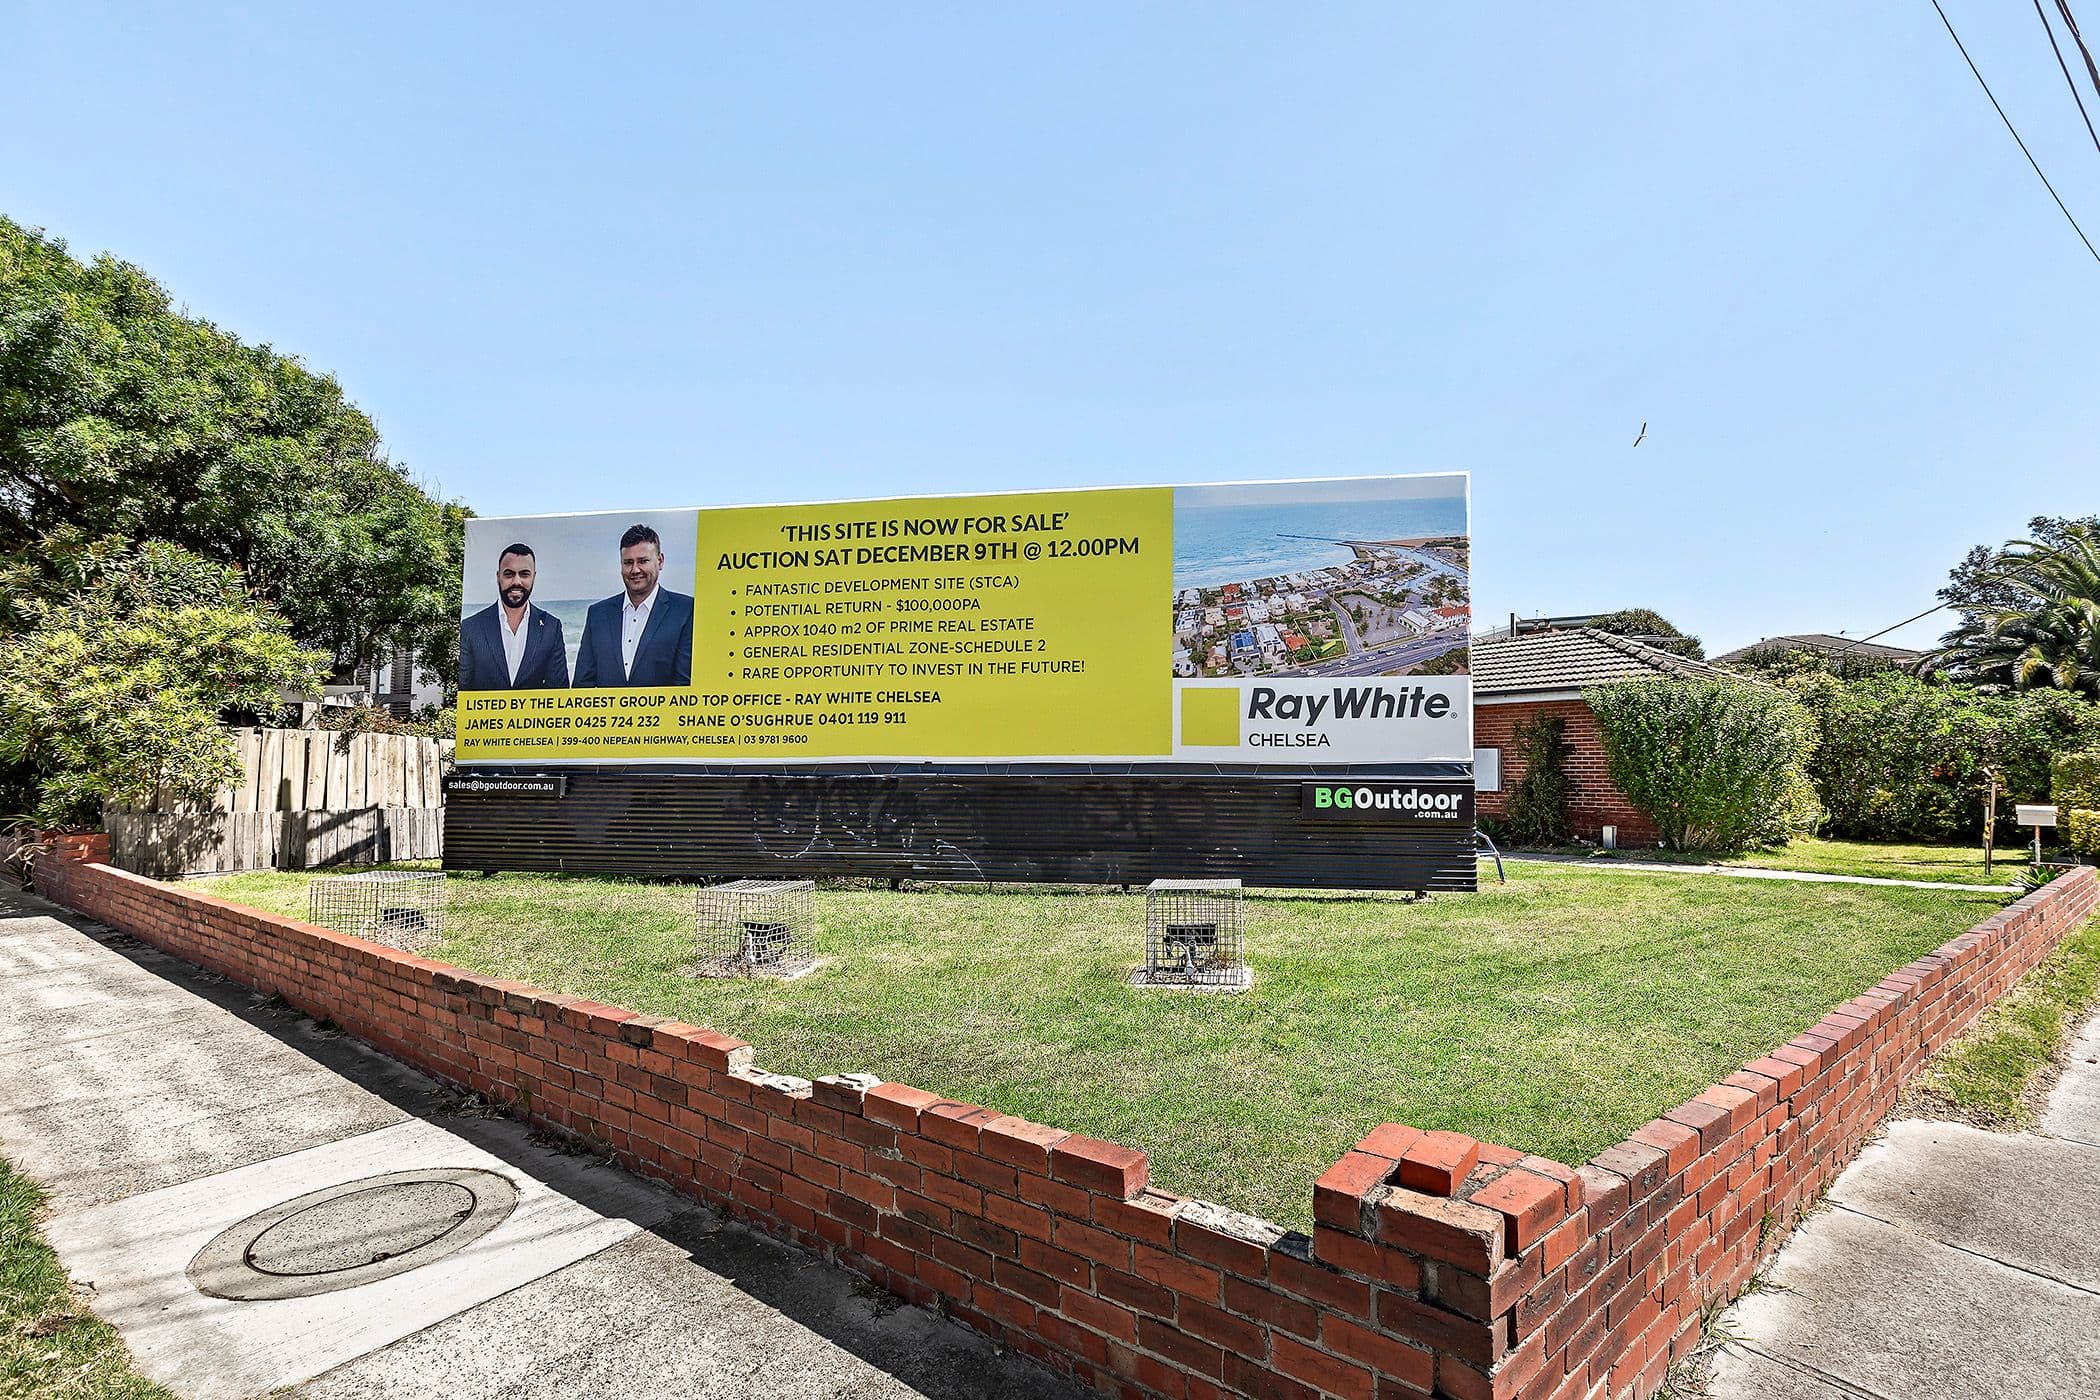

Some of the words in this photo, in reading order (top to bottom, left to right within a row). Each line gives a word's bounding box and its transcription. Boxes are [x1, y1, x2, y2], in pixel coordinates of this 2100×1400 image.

[834, 520, 878, 540] SITE
[881, 519, 899, 538] IS
[903, 517, 960, 537] NOW
[963, 515, 1008, 535] FOR
[716, 550, 809, 571] AUCTION
[813, 547, 853, 567] SAT
[856, 543, 971, 565] DECEMBER
[974, 541, 1018, 561] 9TH
[1023, 541, 1042, 561] @
[1047, 536, 1139, 558] 12.00PM
[745, 582, 820, 597] FANTASTIC
[824, 577, 930, 594] DEVELOPMENT
[933, 576, 965, 590] SITE
[968, 574, 1020, 591] (STCA)
[744, 602, 822, 617] POTENTIAL
[825, 599, 882, 615] RETURN
[895, 597, 981, 614] $100,000PA
[743, 624, 800, 638] APPROX
[802, 622, 837, 637] 1040
[840, 621, 862, 635] m2
[865, 620, 886, 634] OF
[889, 619, 934, 633] PRIME
[937, 619, 976, 633] REAL
[980, 617, 1035, 632] ESTATE
[743, 645, 808, 659] GENERAL
[812, 641, 905, 657] RESIDENTIAL
[908, 639, 1033, 654] ZONE-SCHEDULE
[1037, 638, 1046, 652] 2
[742, 666, 780, 680] RARE
[783, 663, 885, 679] OPPORTUNITY
[887, 662, 908, 676] TO
[912, 662, 964, 676] INVEST
[968, 662, 983, 676] IN
[987, 661, 1017, 675] THE
[1021, 659, 1085, 674] FUTURE!
[466, 698, 507, 711] LISTED
[510, 697, 527, 710] BY
[529, 696, 555, 710] THE
[557, 695, 617, 709] LARGEST
[619, 694, 666, 708] GROUP
[668, 694, 699, 707] AND
[701, 694, 729, 707] TOP
[732, 693, 782, 706] OFFICE
[794, 692, 823, 706] RAY
[825, 690, 873, 705] WHITE
[875, 690, 942, 704] CHELSEA
[464, 718, 504, 731] JAMES
[506, 716, 572, 730] ALDINGER
[574, 715, 607, 729] 0425
[610, 715, 634, 728] 724
[636, 714, 660, 728] 232
[678, 714, 726, 727] SHANE
[730, 713, 814, 727] O’SUGHRUE
[818, 712, 855, 726] 0401
[857, 711, 879, 725] 119
[883, 711, 907, 724] 911
[463, 737, 481, 748] RAY
[482, 737, 512, 747] WHITE
[512, 736, 554, 747] CHELSEA
[561, 735, 601, 746] 399-400
[602, 735, 641, 745] NEPEAN
[642, 735, 690, 746] HIGHWAY,
[691, 734, 736, 745] CHELSEA
[743, 734, 756, 745] 03
[758, 734, 780, 745] 9781
[781, 734, 809, 744] 9600
[1248, 732, 1331, 748] CHELSEA
[448, 780, 554, 792] sales@bgoutdoor.com.au
[1314, 786, 1463, 811] BGOutdoor
[1413, 810, 1458, 819] .com.au
